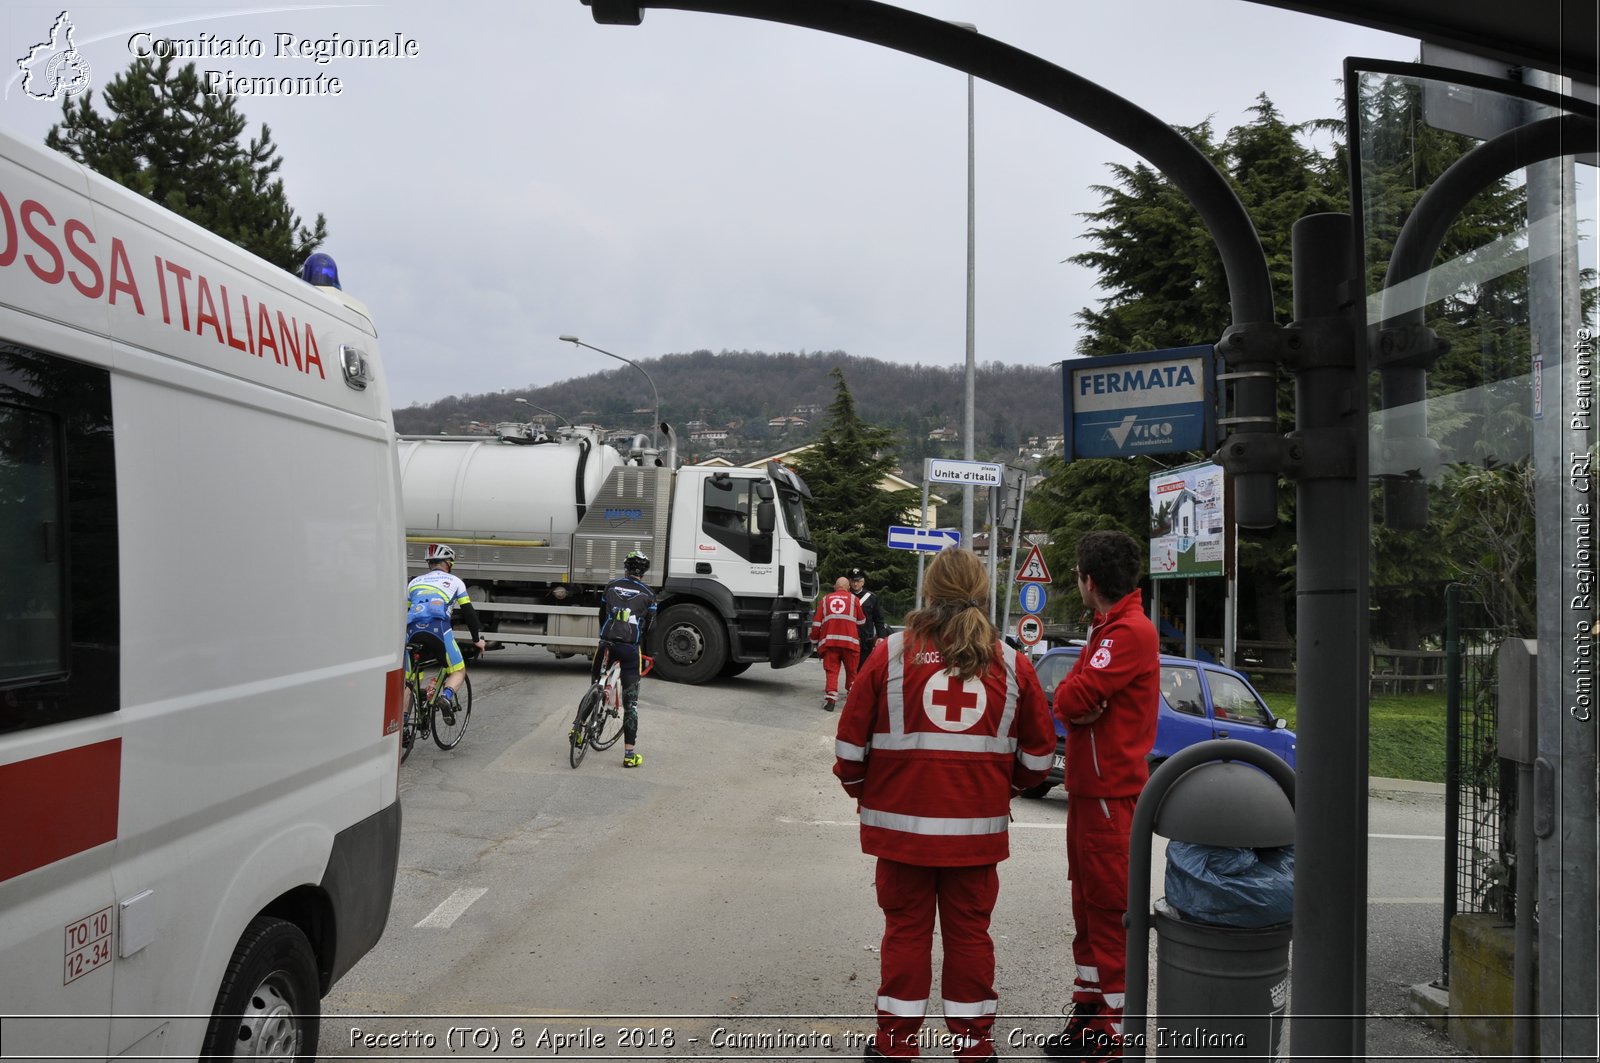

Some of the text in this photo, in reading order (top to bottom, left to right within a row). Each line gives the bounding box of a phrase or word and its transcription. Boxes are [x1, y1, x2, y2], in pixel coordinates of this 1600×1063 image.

[154, 255, 326, 380] ITALIANA
[1080, 365, 1195, 396] FERMATA
[964, 471, 996, 482] d'Italia
[69, 913, 107, 949] TO 10
